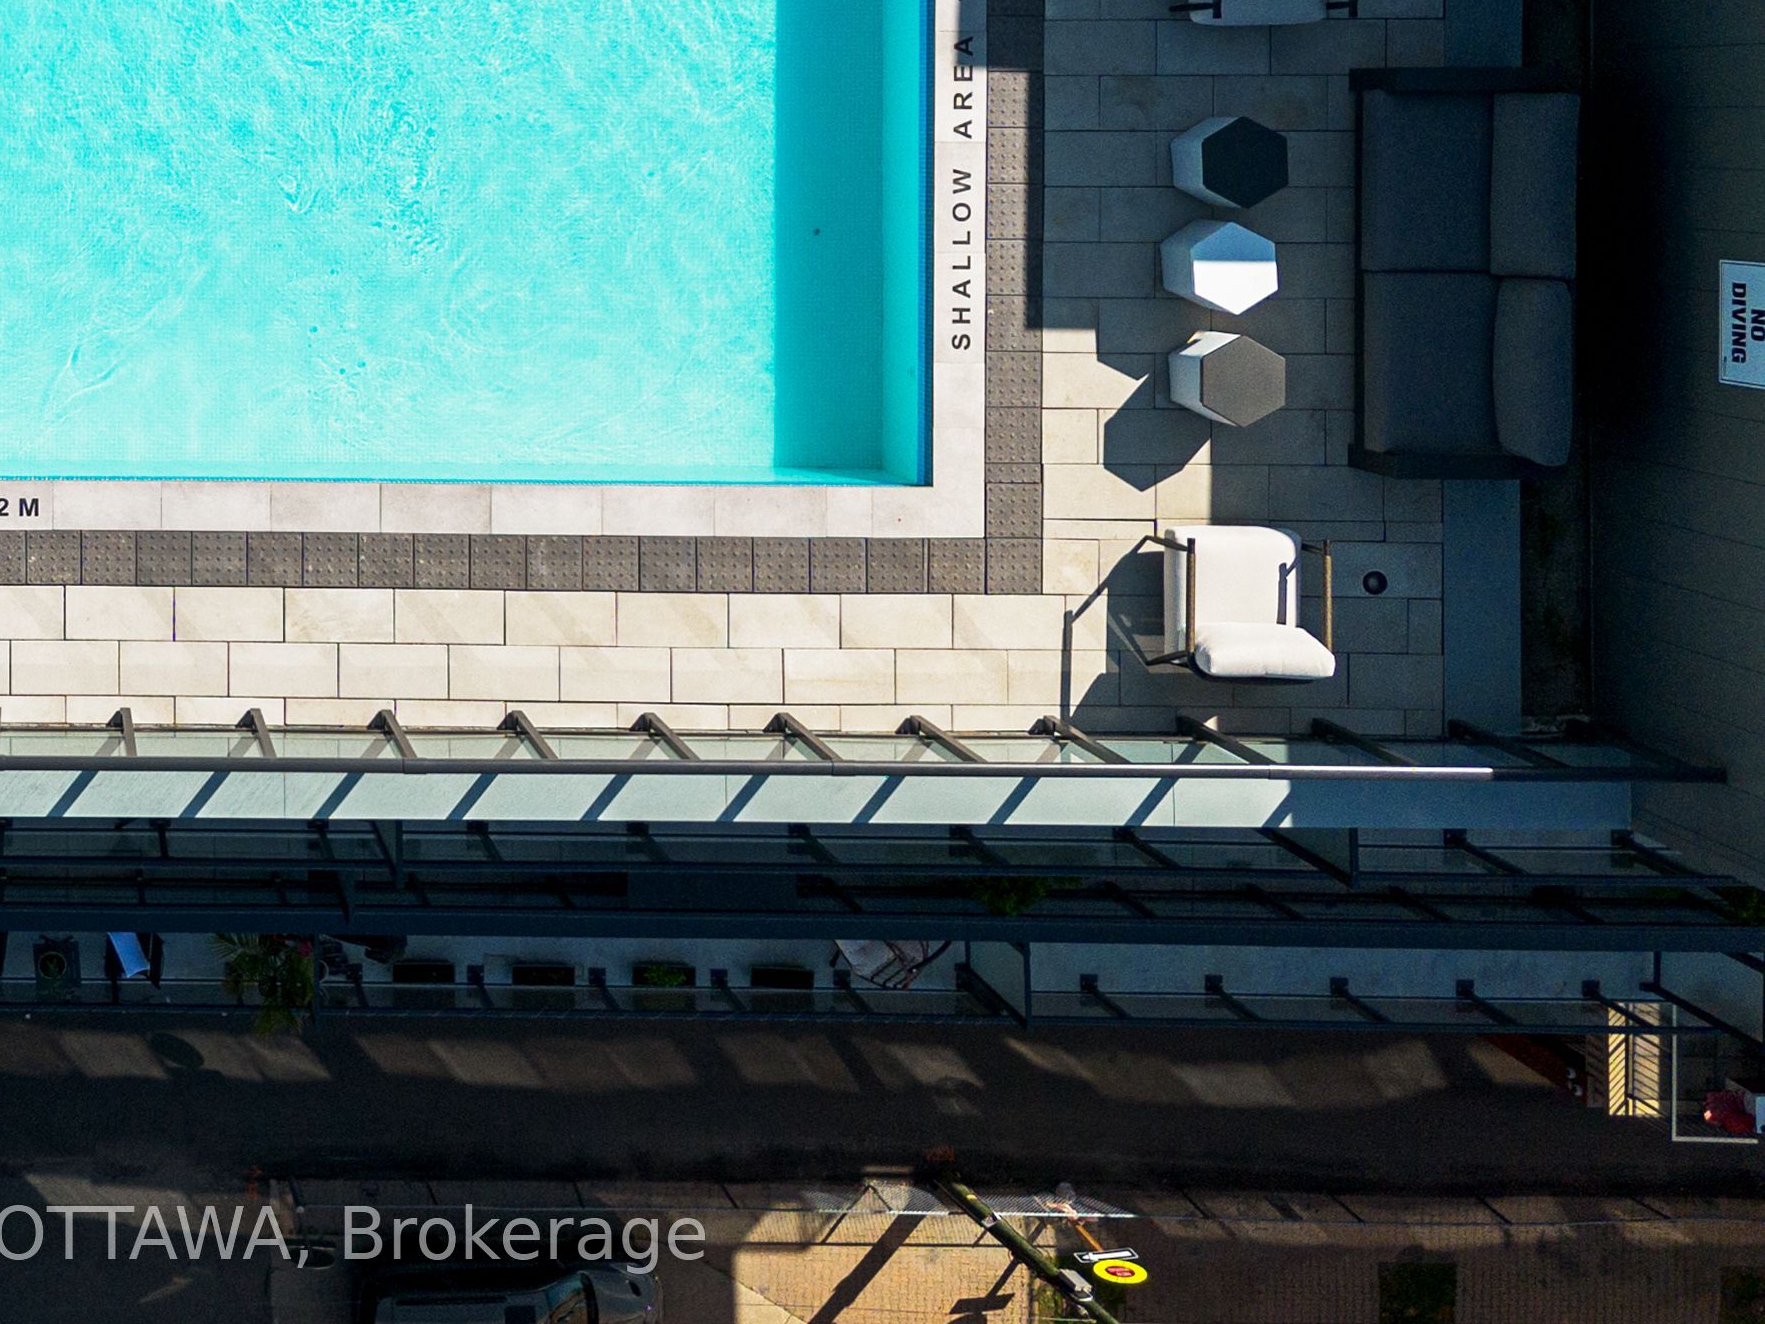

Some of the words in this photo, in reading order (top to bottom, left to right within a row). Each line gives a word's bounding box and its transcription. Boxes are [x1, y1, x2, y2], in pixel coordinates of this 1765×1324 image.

[953, 36, 974, 139] AREA
[951, 168, 972, 351] SHALLOW
[1731, 282, 1747, 364] DIVING
[1750, 308, 1765, 342] NO
